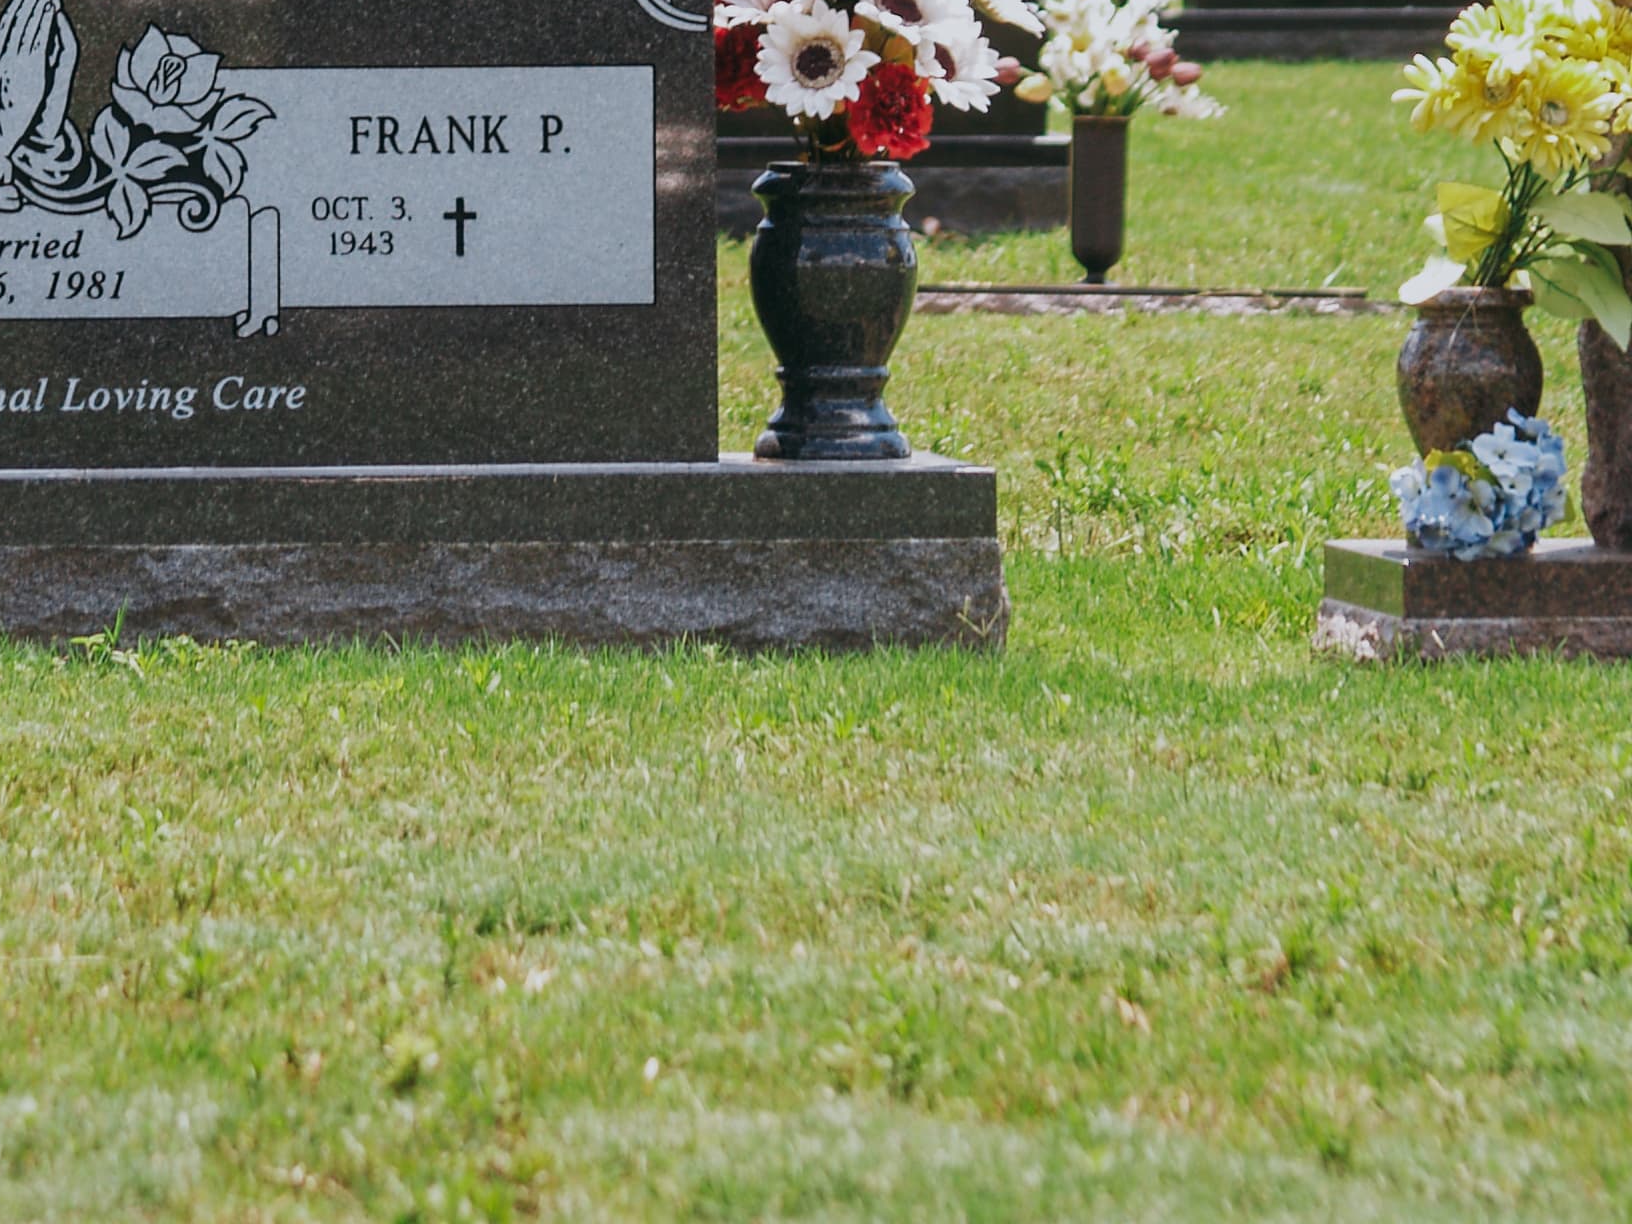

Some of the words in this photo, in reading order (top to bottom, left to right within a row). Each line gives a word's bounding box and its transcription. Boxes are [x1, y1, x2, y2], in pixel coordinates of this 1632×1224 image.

[349, 114, 510, 155] FRANK
[539, 114, 571, 154] P.
[311, 196, 374, 221] OCT.
[330, 230, 394, 256] 1943
[45, 270, 125, 300] 1981
[60, 377, 198, 420] Loving
[212, 376, 307, 411] Care
